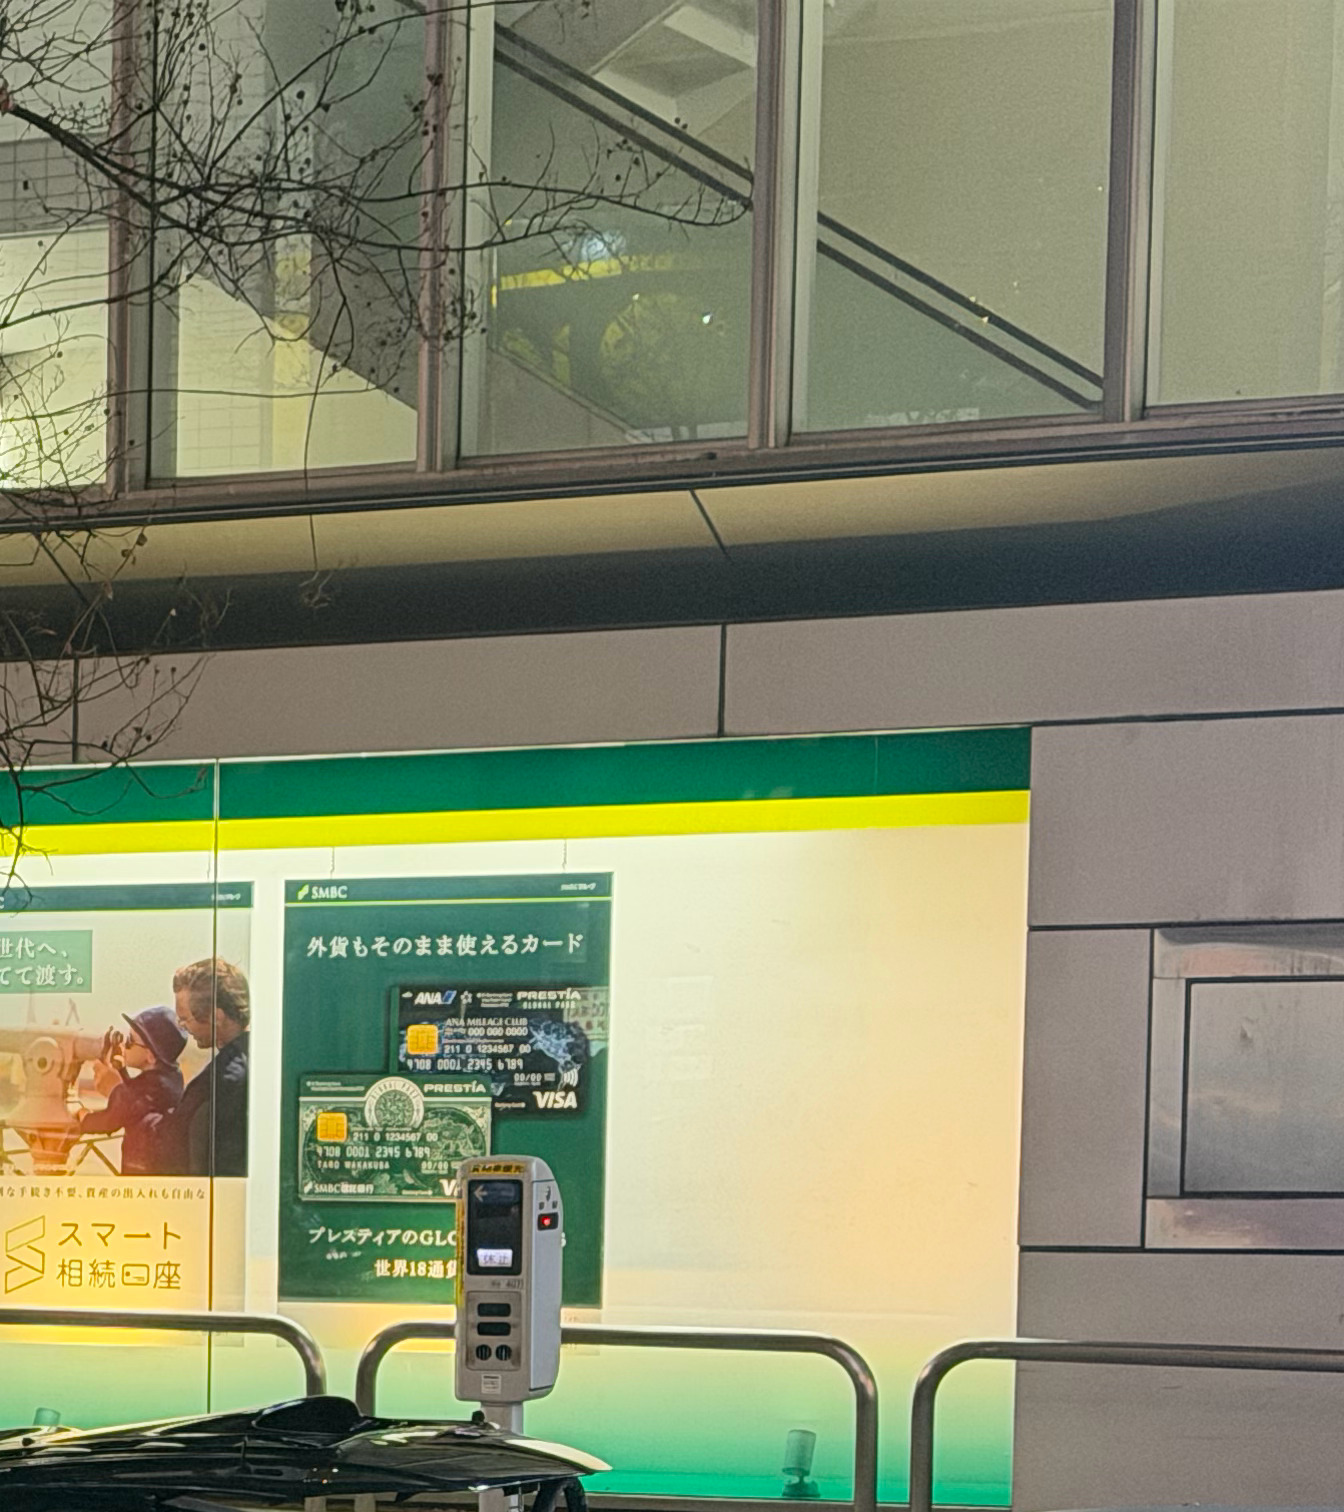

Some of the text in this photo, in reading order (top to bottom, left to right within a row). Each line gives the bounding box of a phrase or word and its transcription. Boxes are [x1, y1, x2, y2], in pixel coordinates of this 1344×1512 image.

[311, 885, 348, 899] SMBC
[307, 932, 584, 959] 外貨もそのまま使えるカード
[517, 987, 581, 1000] PRESTÍA
[423, 1080, 487, 1093] PRESTÍA
[533, 1091, 578, 1109] VISA
[58, 1221, 181, 1250] スマート
[56, 1258, 181, 1290] 相続口座
